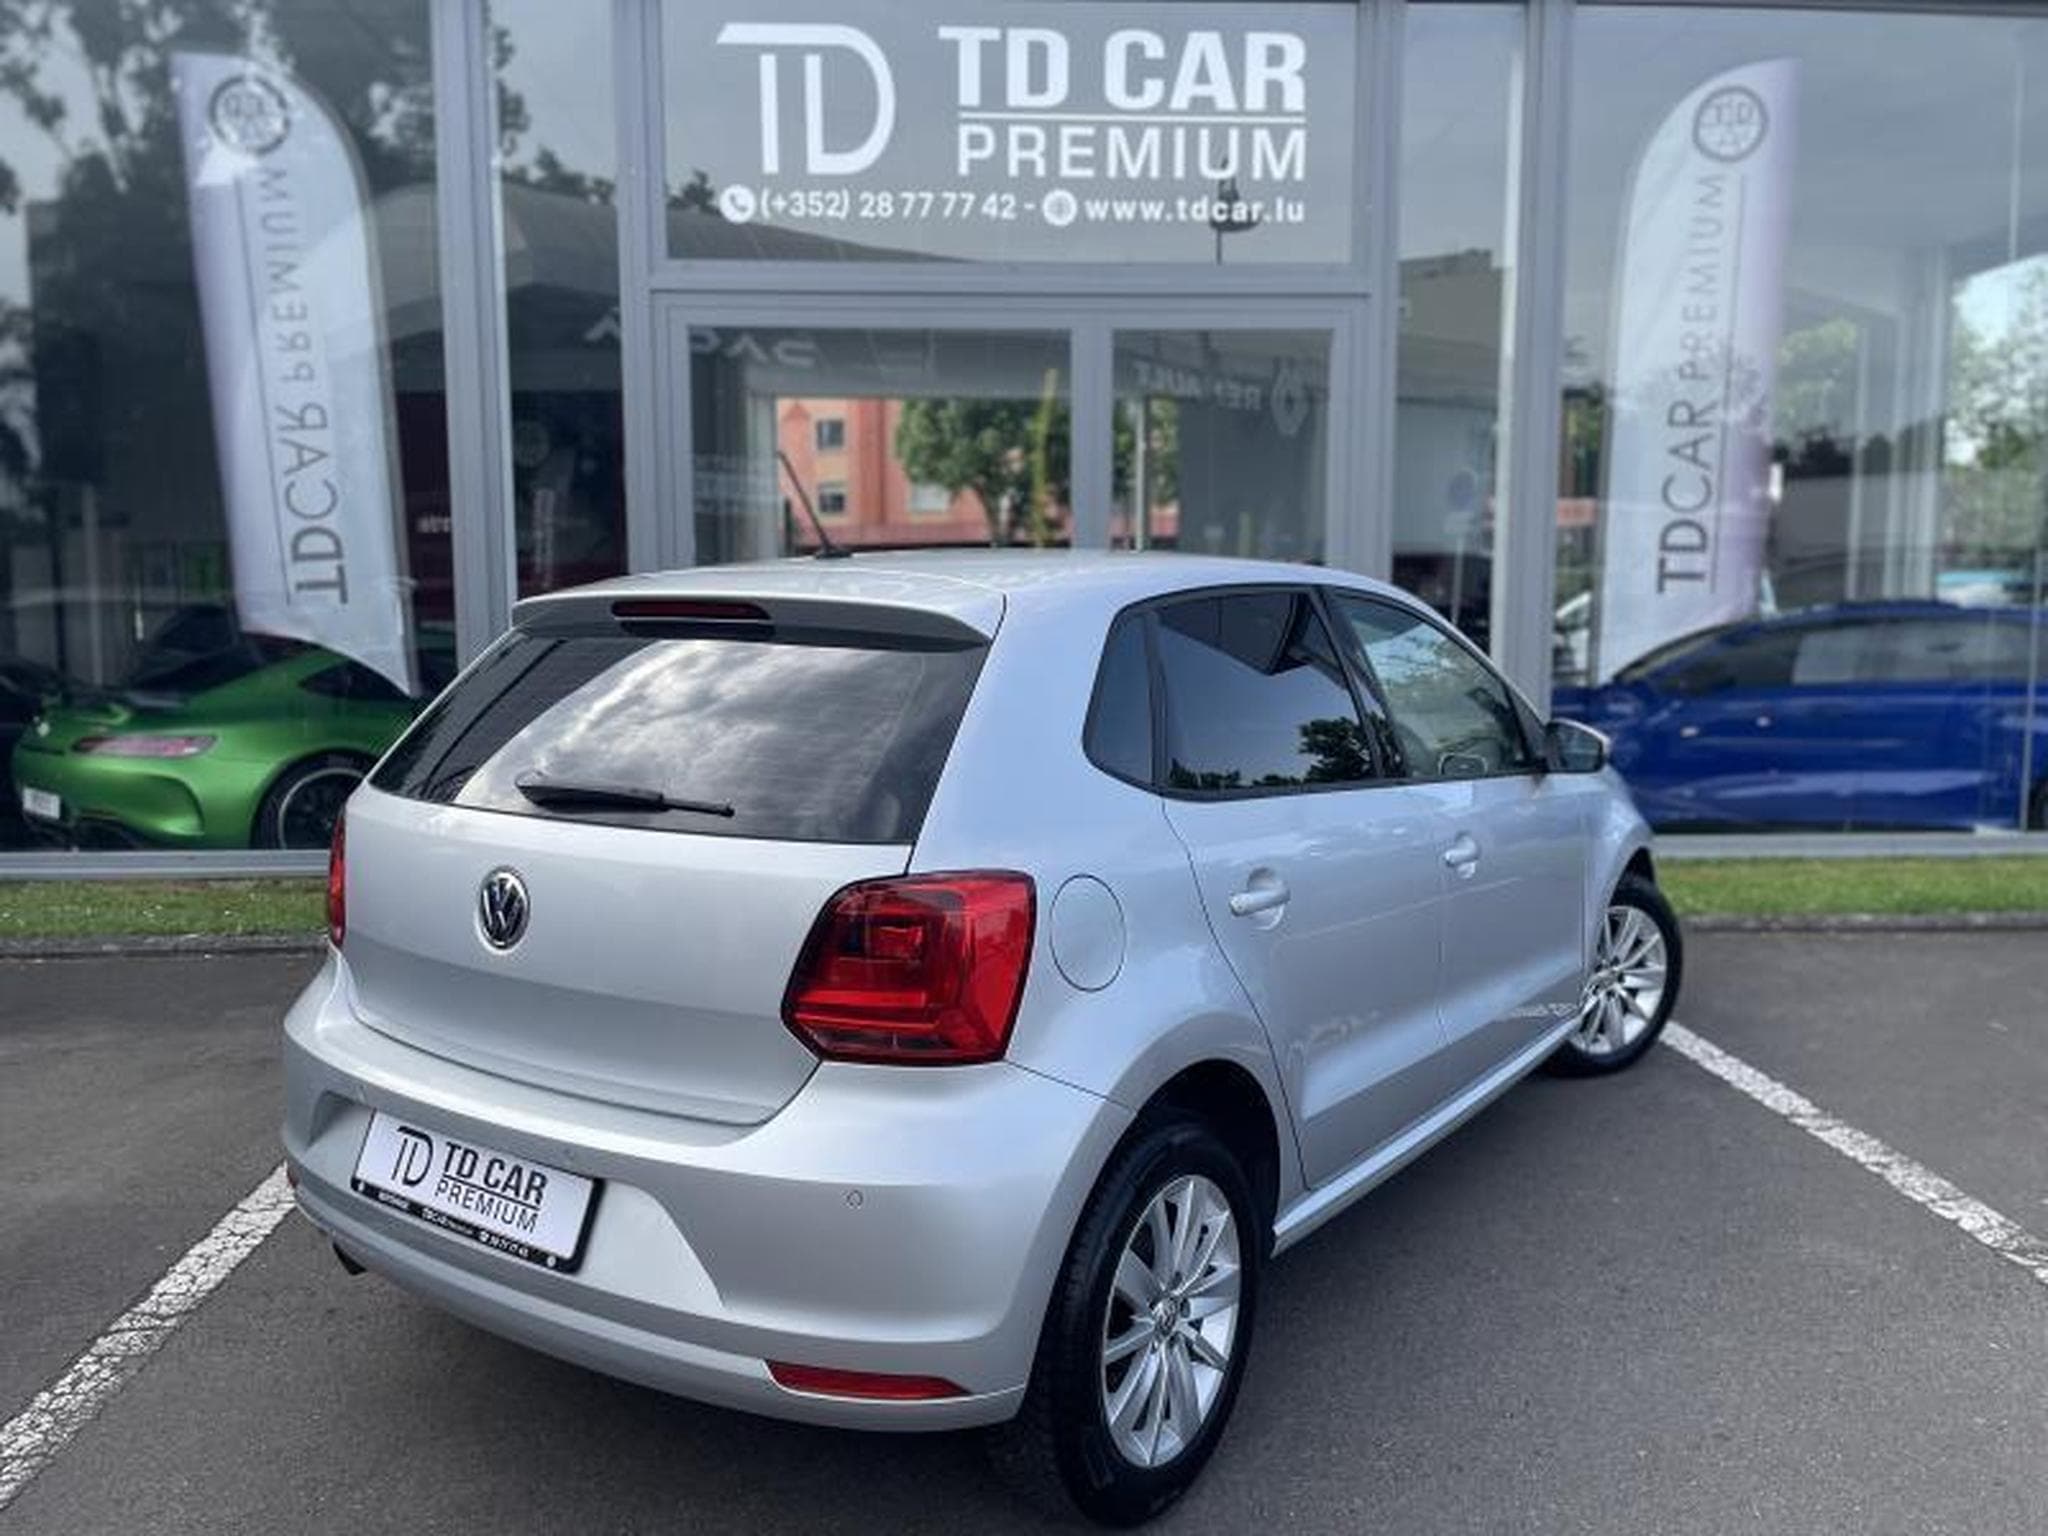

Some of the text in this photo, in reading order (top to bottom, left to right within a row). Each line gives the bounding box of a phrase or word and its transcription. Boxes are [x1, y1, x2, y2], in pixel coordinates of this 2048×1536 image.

[716, 22, 896, 175] TD
[938, 26, 1307, 112] TD CAR
[957, 123, 1307, 181] PREMIUM
[760, 187, 850, 219] (+352)
[859, 191, 894, 218] 28
[901, 191, 935, 218] 77
[941, 192, 976, 218] 77
[981, 193, 1018, 220] 42
[1084, 197, 1305, 222] www.tdcar.lu
[1656, 173, 1726, 594] TDCAR PREMIUM
[434, 1179, 538, 1233] PREMIUM
[443, 1141, 548, 1206] TD CAR
